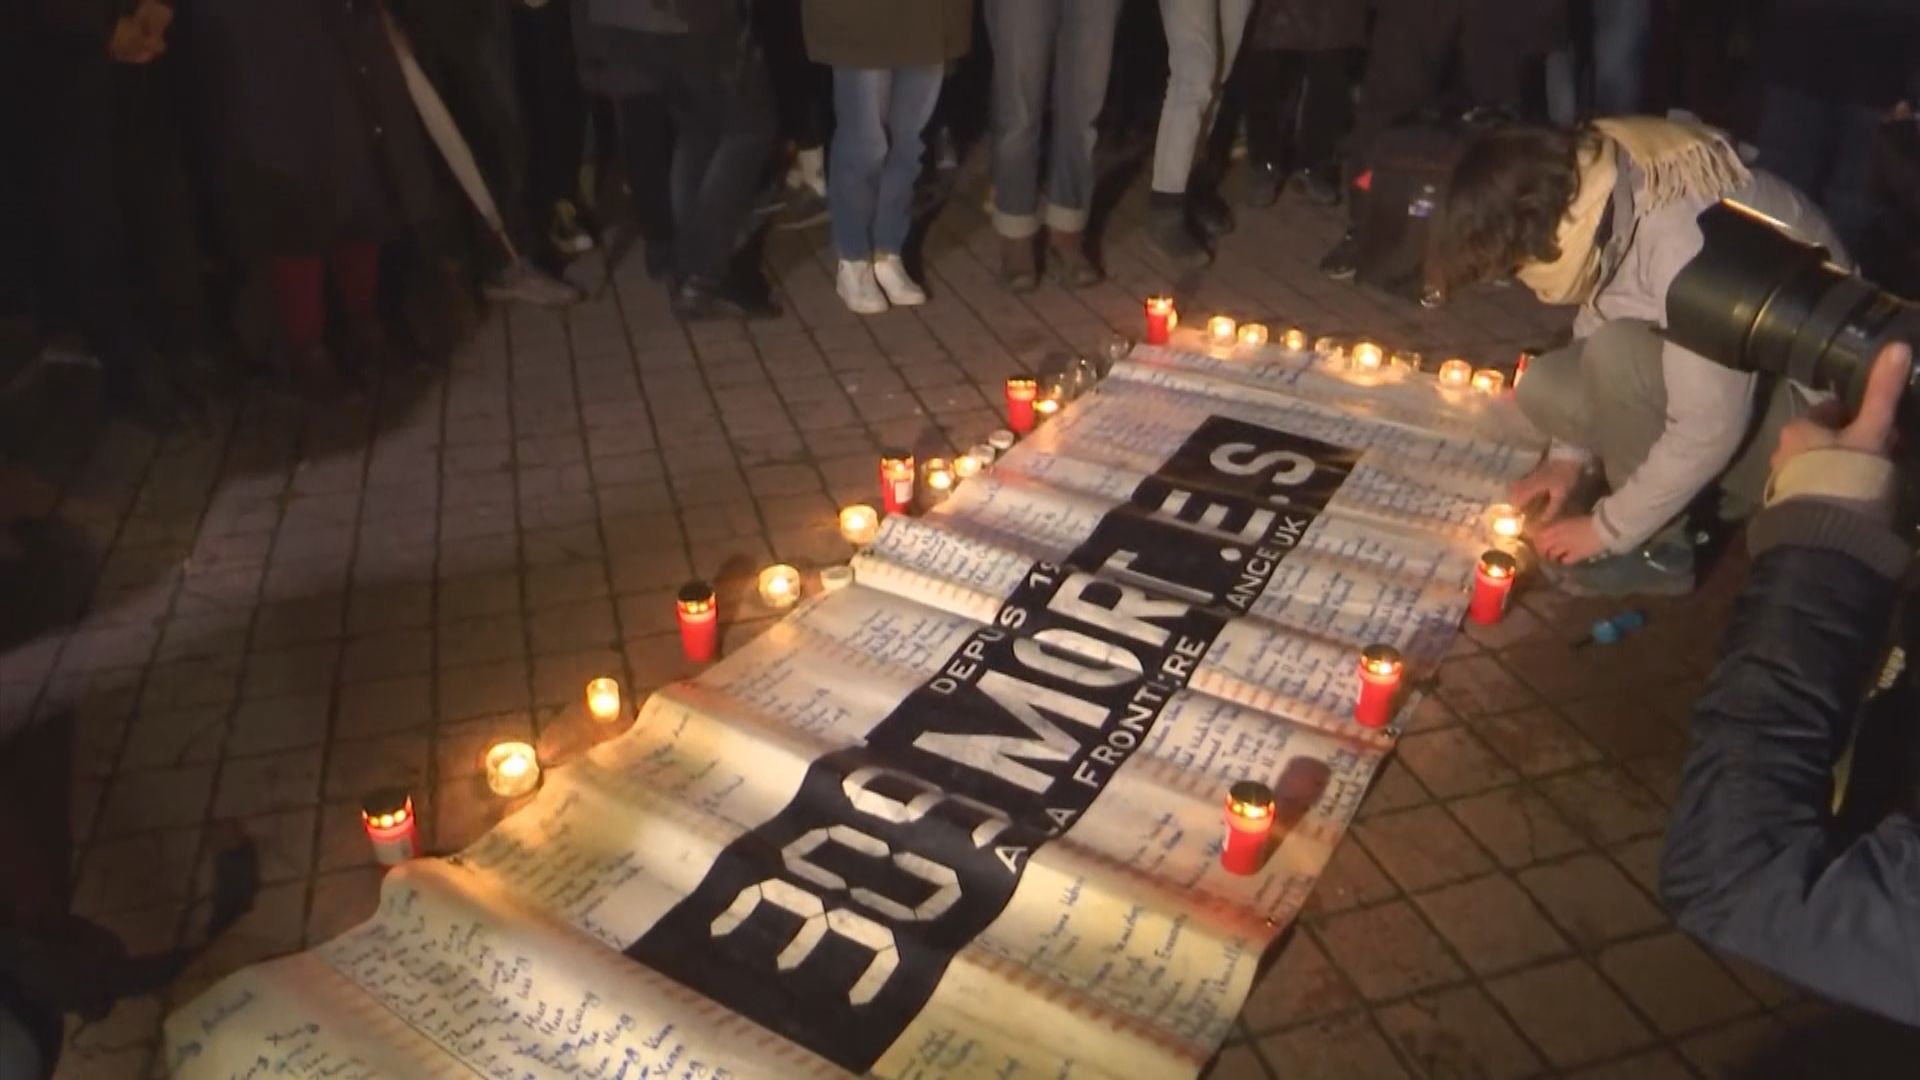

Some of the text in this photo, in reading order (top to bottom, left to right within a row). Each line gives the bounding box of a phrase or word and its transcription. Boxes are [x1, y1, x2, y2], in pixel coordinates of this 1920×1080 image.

[994, 846, 1028, 875] A
[1072, 635, 1206, 788] FRONTIRE
[1271, 516, 1309, 546] UK
[710, 766, 1012, 1006] 309
